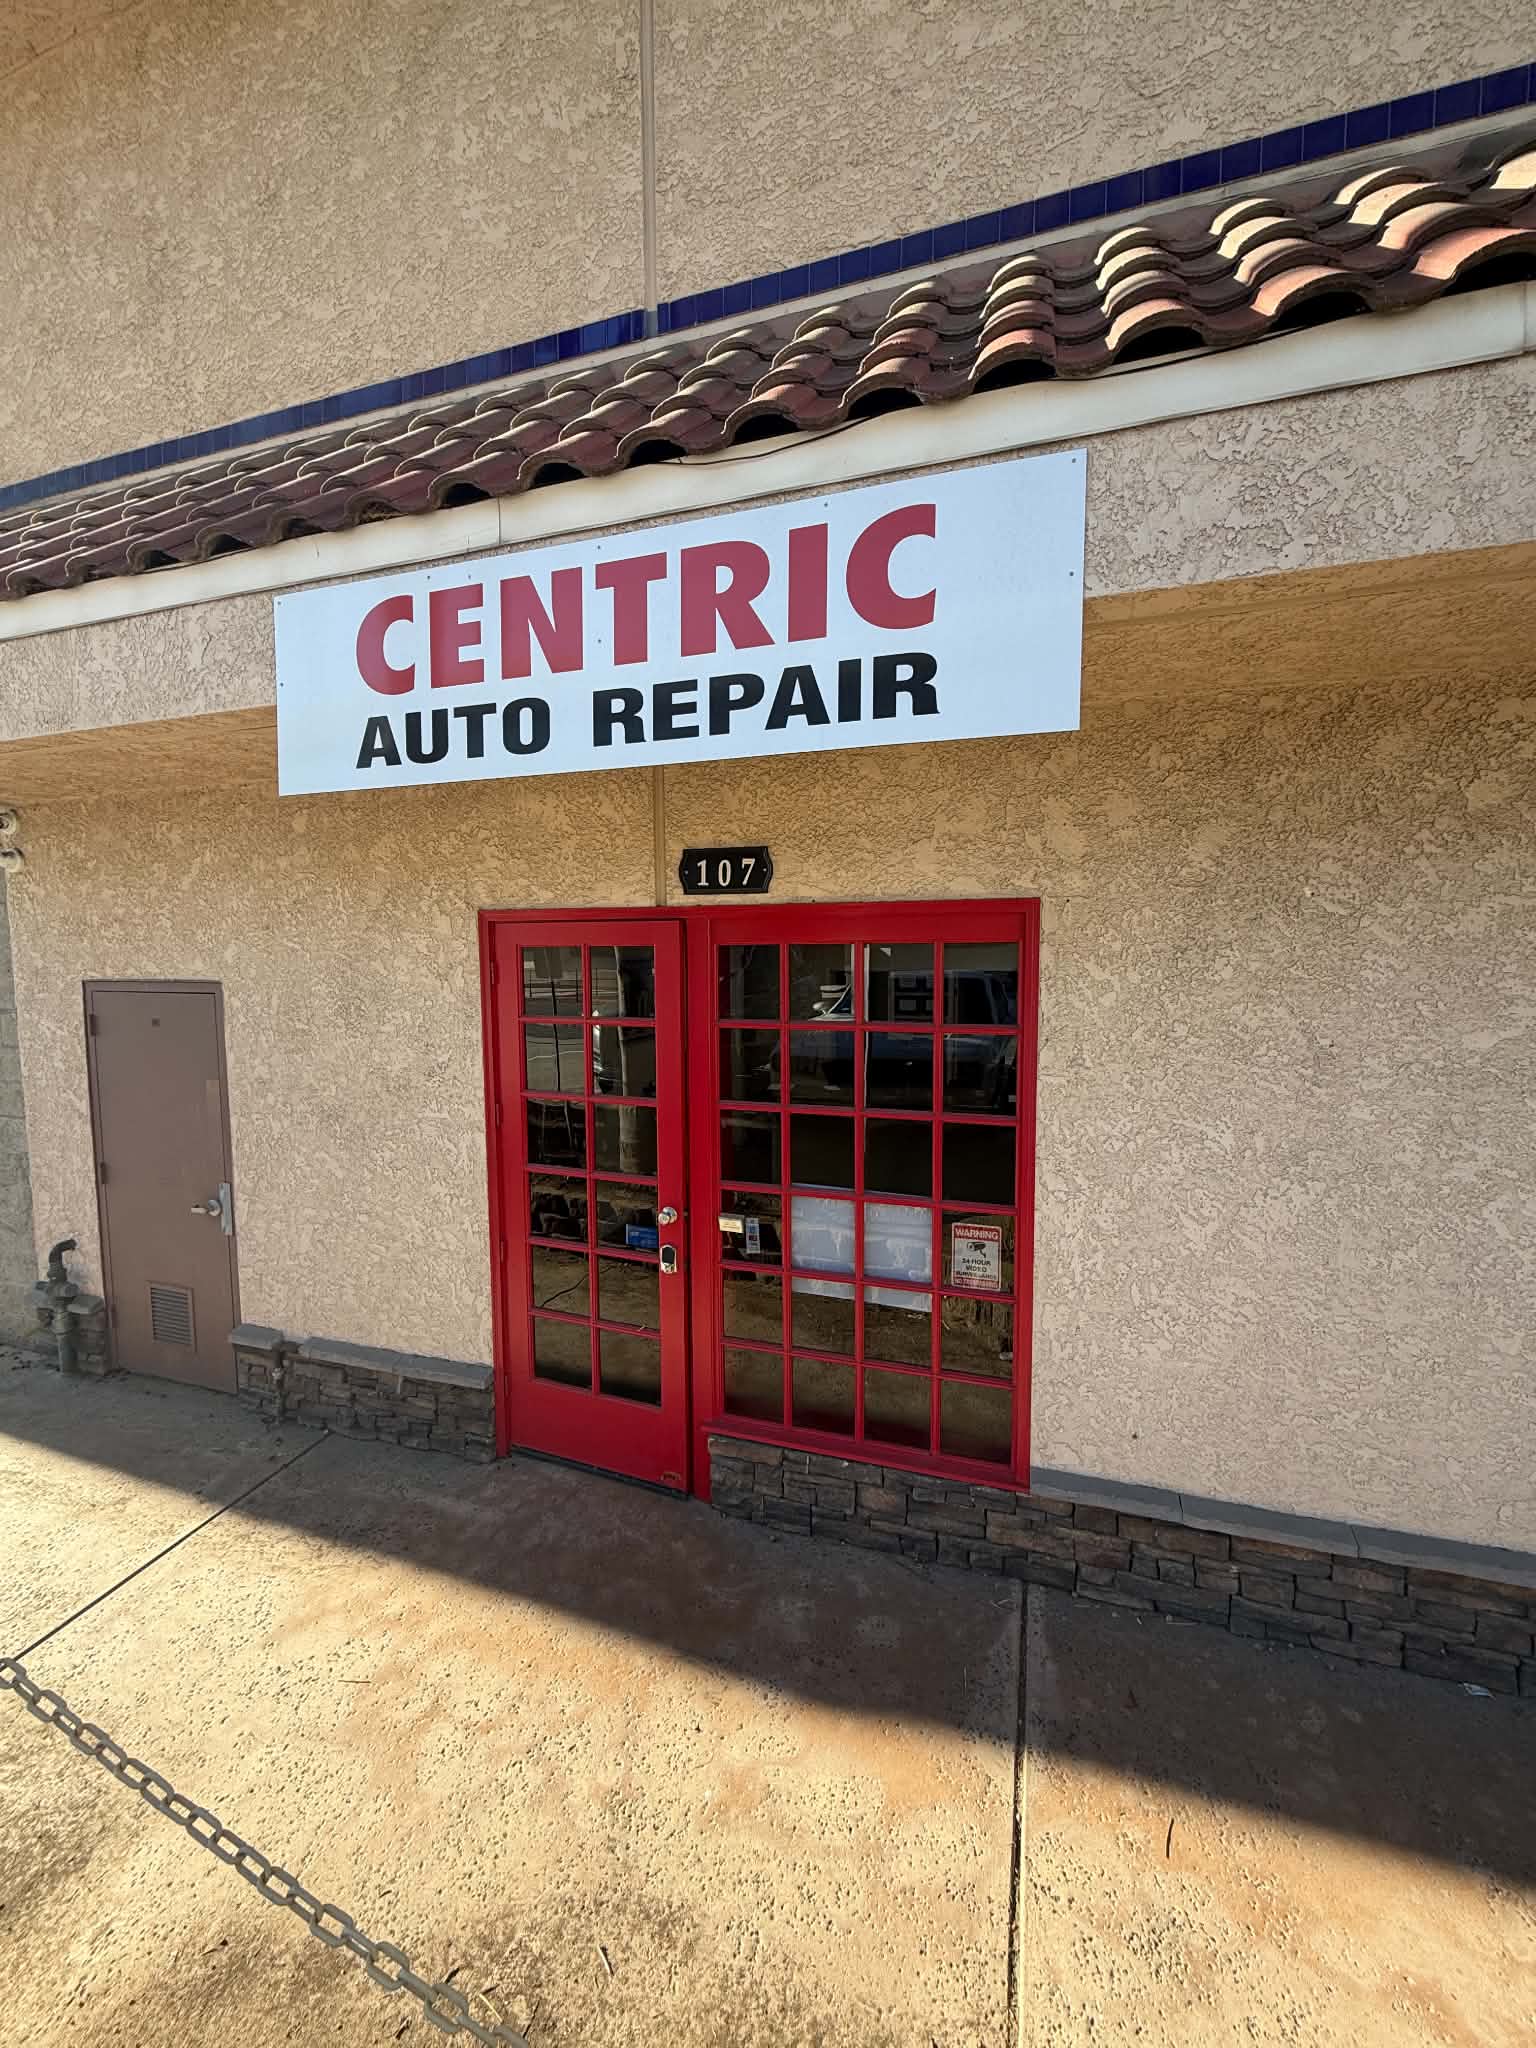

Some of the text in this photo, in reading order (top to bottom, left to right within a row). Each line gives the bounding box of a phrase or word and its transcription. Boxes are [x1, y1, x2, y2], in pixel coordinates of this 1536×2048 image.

[356, 503, 937, 696] CENTRIC
[356, 652, 941, 769] AUTO REPAIR
[696, 857, 757, 887] 107
[955, 1227, 999, 1240] WARNING
[971, 1259, 992, 1267] HOUR
